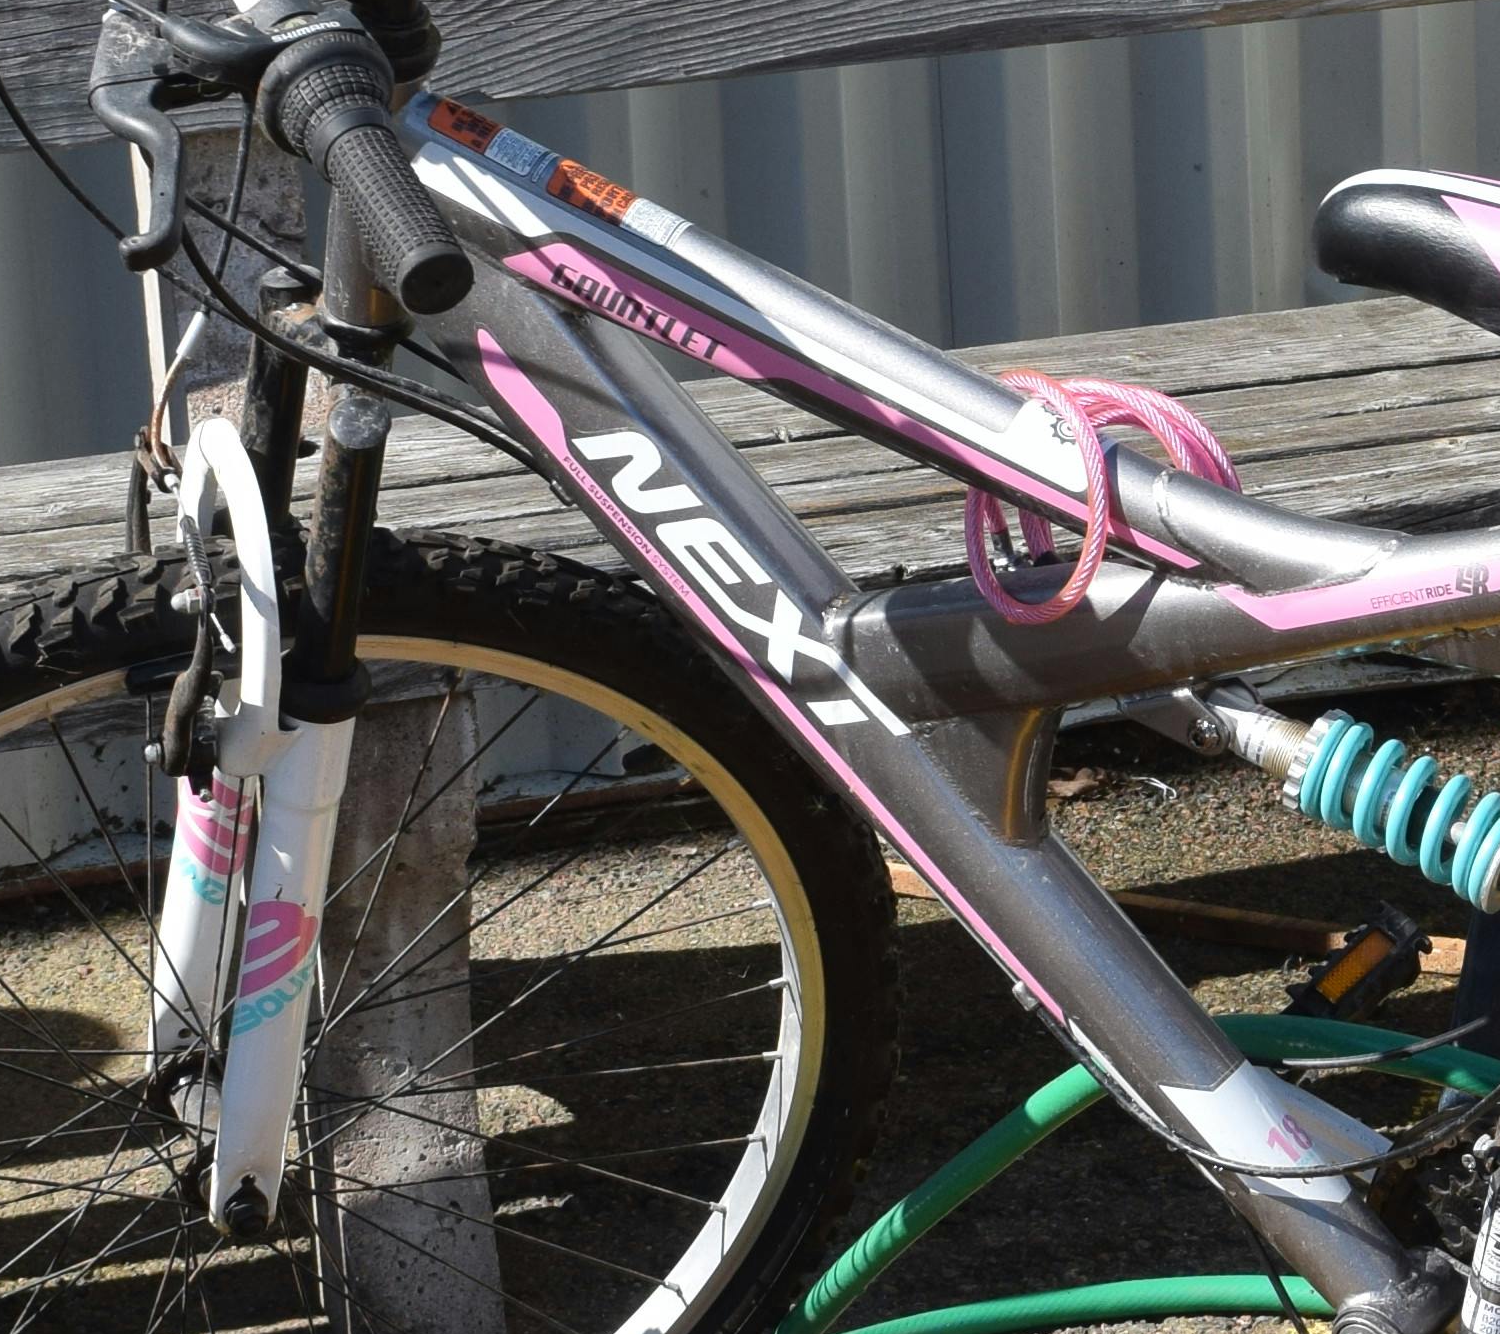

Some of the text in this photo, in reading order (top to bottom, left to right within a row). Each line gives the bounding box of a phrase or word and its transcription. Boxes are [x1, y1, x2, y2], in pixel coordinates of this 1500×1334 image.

[270, 20, 341, 43] SHIMANO
[550, 263, 727, 360] GAUNTLET
[563, 455, 690, 597] FULL SUSPENSION SYSTEM
[572, 431, 912, 737] NEXT
[1266, 1113, 1313, 1163] 18
